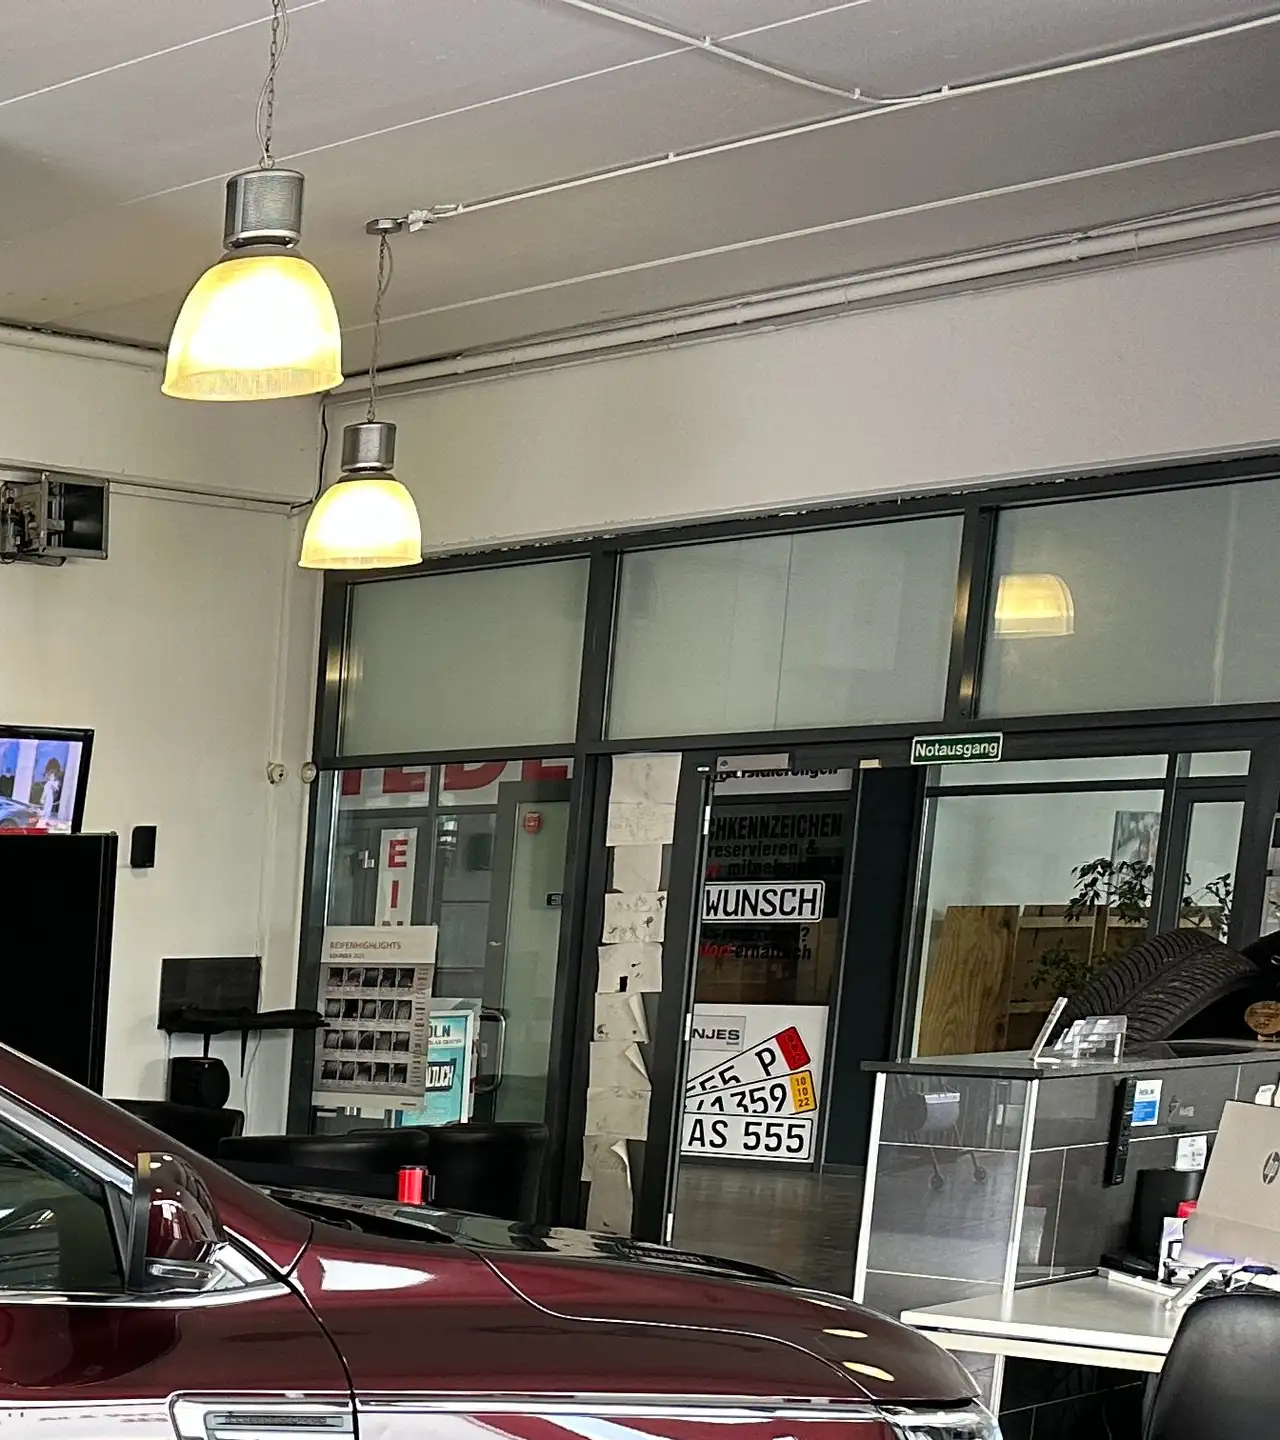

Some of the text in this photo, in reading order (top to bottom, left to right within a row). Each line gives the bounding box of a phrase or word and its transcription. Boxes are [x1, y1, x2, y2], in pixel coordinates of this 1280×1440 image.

[915, 743, 998, 758] Notausgang
[705, 888, 818, 917] WUNSCH
[329, 941, 402, 950] REIFENHIGHLIGHTS
[795, 1076, 807, 1087] 10
[797, 1087, 809, 1097] 10
[798, 1097, 811, 1108] 22
[688, 1118, 806, 1154] AS 555
